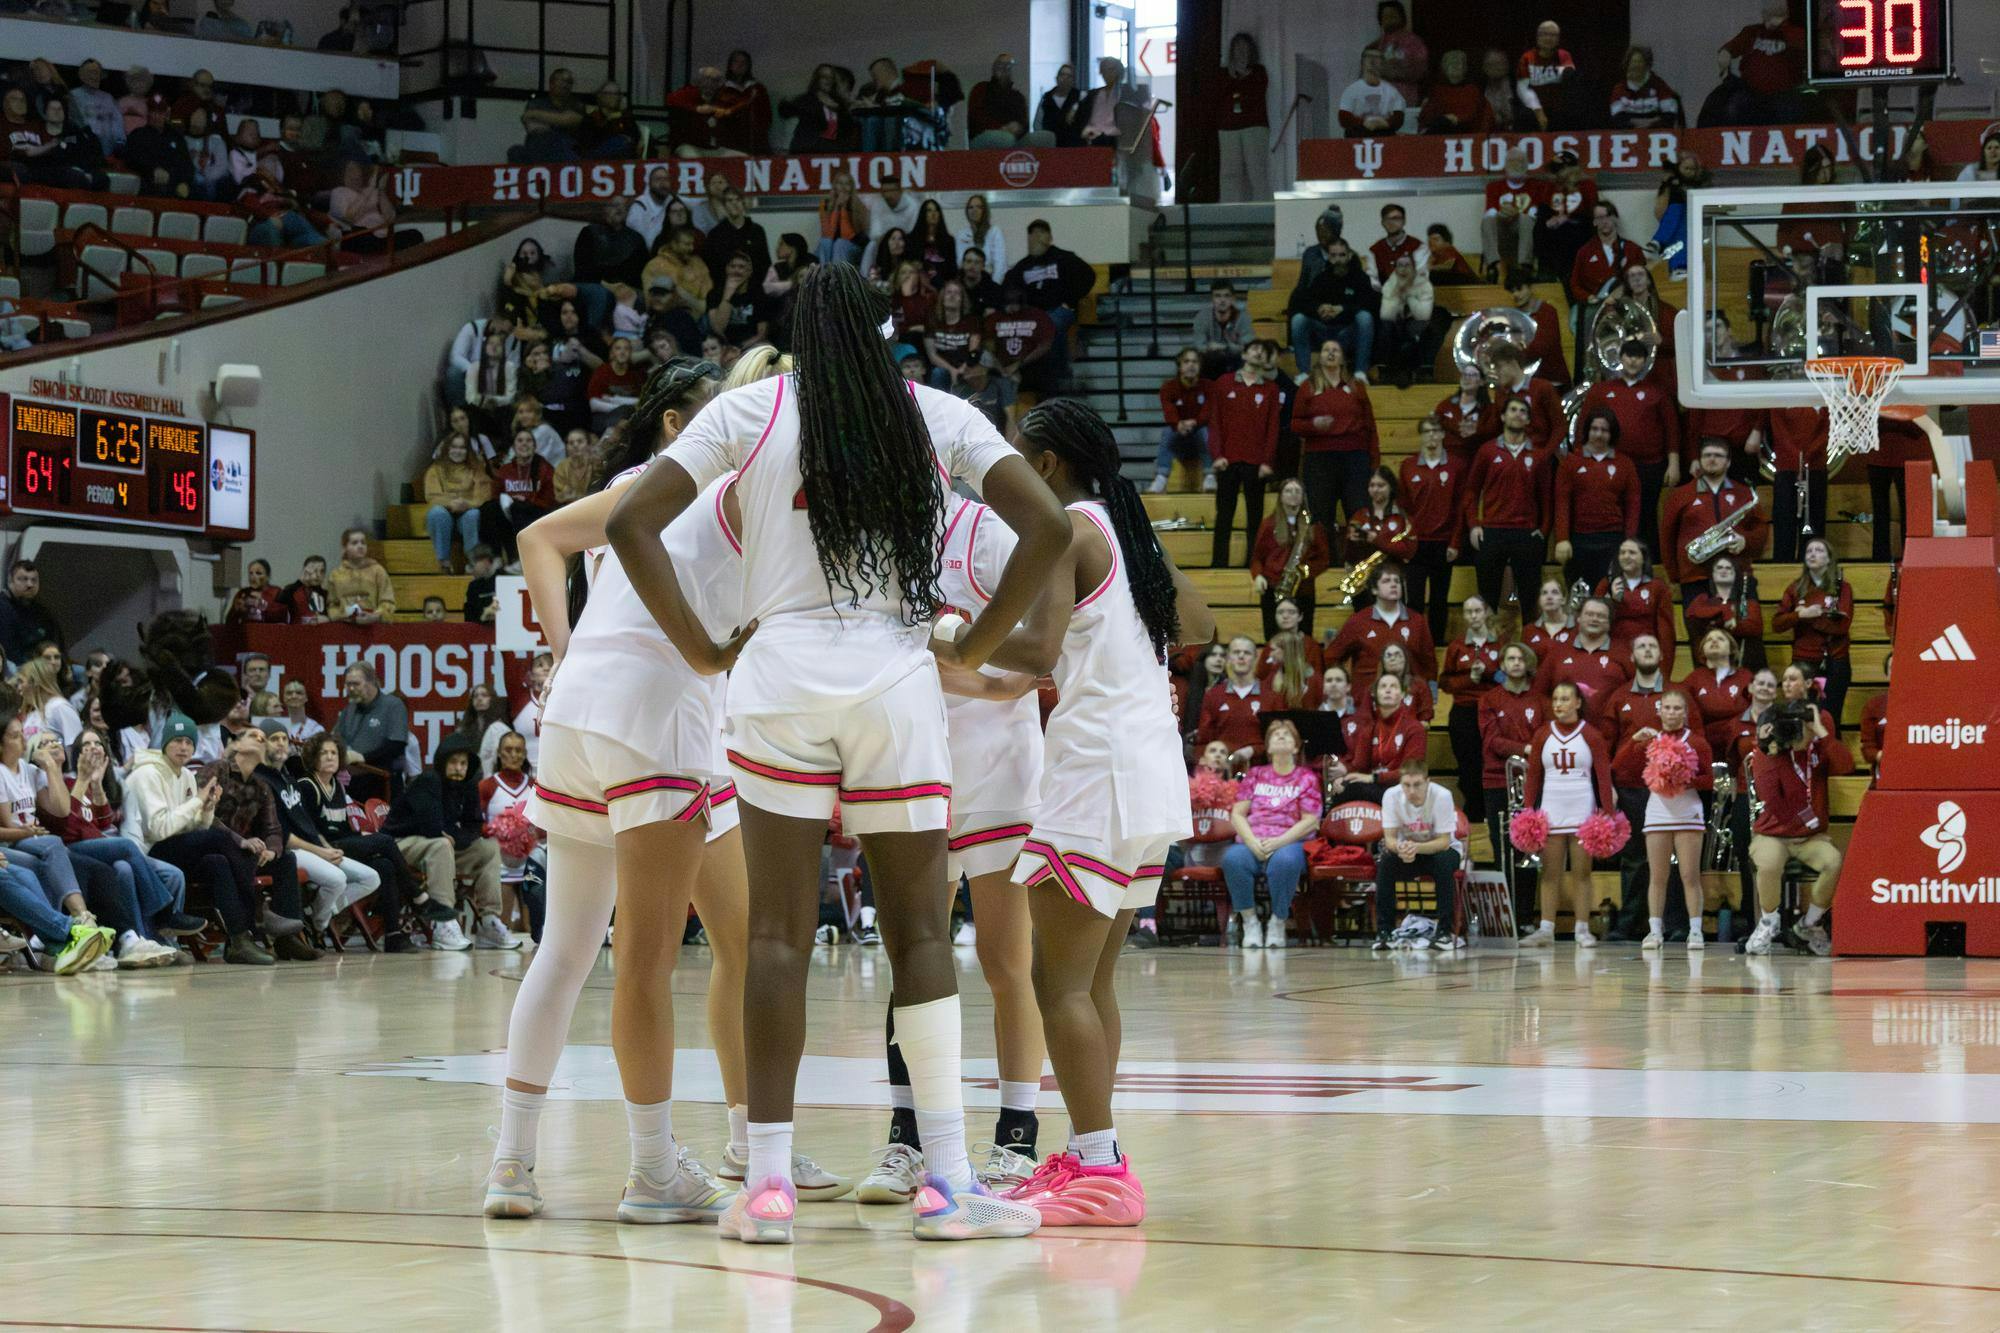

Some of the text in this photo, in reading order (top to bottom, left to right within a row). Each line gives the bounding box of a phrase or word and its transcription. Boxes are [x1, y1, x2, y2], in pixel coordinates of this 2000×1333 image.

[1839, 0, 1923, 66] 30
[1844, 67, 1914, 78] DAKTRONICS
[1444, 133, 1678, 173] HOOSIER
[744, 156, 928, 192] NATION
[32, 378, 66, 399] SIMON
[109, 390, 160, 412] ASSEMBLY
[161, 398, 185, 417] HALL
[16, 405, 76, 438] INDIANA
[96, 419, 141, 465] 6:25
[150, 425, 200, 455] PURDUE
[26, 451, 53, 493] 64
[87, 482, 128, 506] PERIOD 4
[173, 471, 197, 511] 46
[1908, 718, 1987, 750] meijer
[1331, 806, 1382, 821] INDIANA
[1871, 877, 2000, 904] Smithvill
